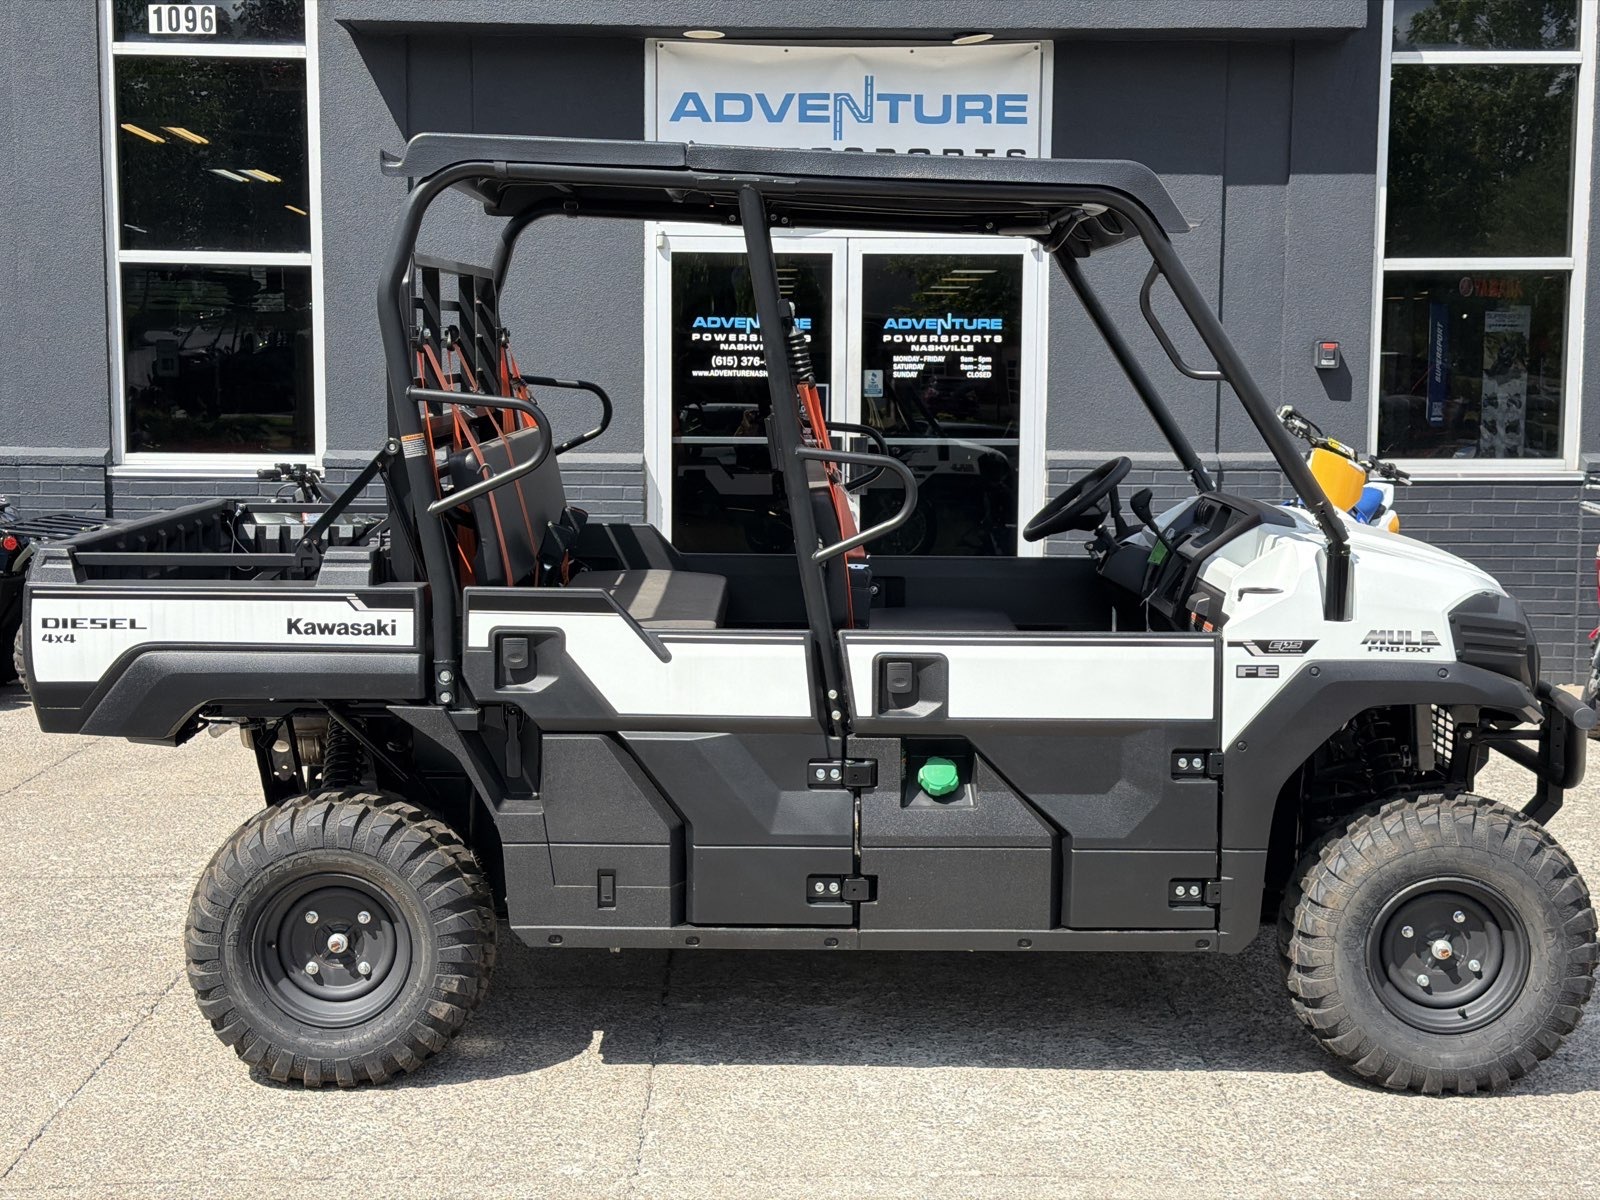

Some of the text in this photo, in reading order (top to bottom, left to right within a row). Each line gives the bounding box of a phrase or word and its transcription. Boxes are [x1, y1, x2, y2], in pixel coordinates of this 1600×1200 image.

[152, 5, 214, 33] 1096
[668, 75, 1029, 141] ADVENTURE
[883, 312, 1003, 335] ADVENTURE
[882, 334, 1003, 343] POWERSPORTS
[910, 344, 974, 352] NASHVILLE
[1434, 321, 1444, 384] SUPERSPORT
[711, 355, 738, 368] (615)
[892, 363, 925, 371] SATURDAY
[892, 371, 992, 379] SUNDAY CLOSED
[41, 617, 148, 630] DIESEL
[286, 617, 397, 636] Kawasaki
[41, 633, 77, 644] 4x4
[1360, 629, 1442, 646] MULE
[1237, 666, 1279, 677] FE
